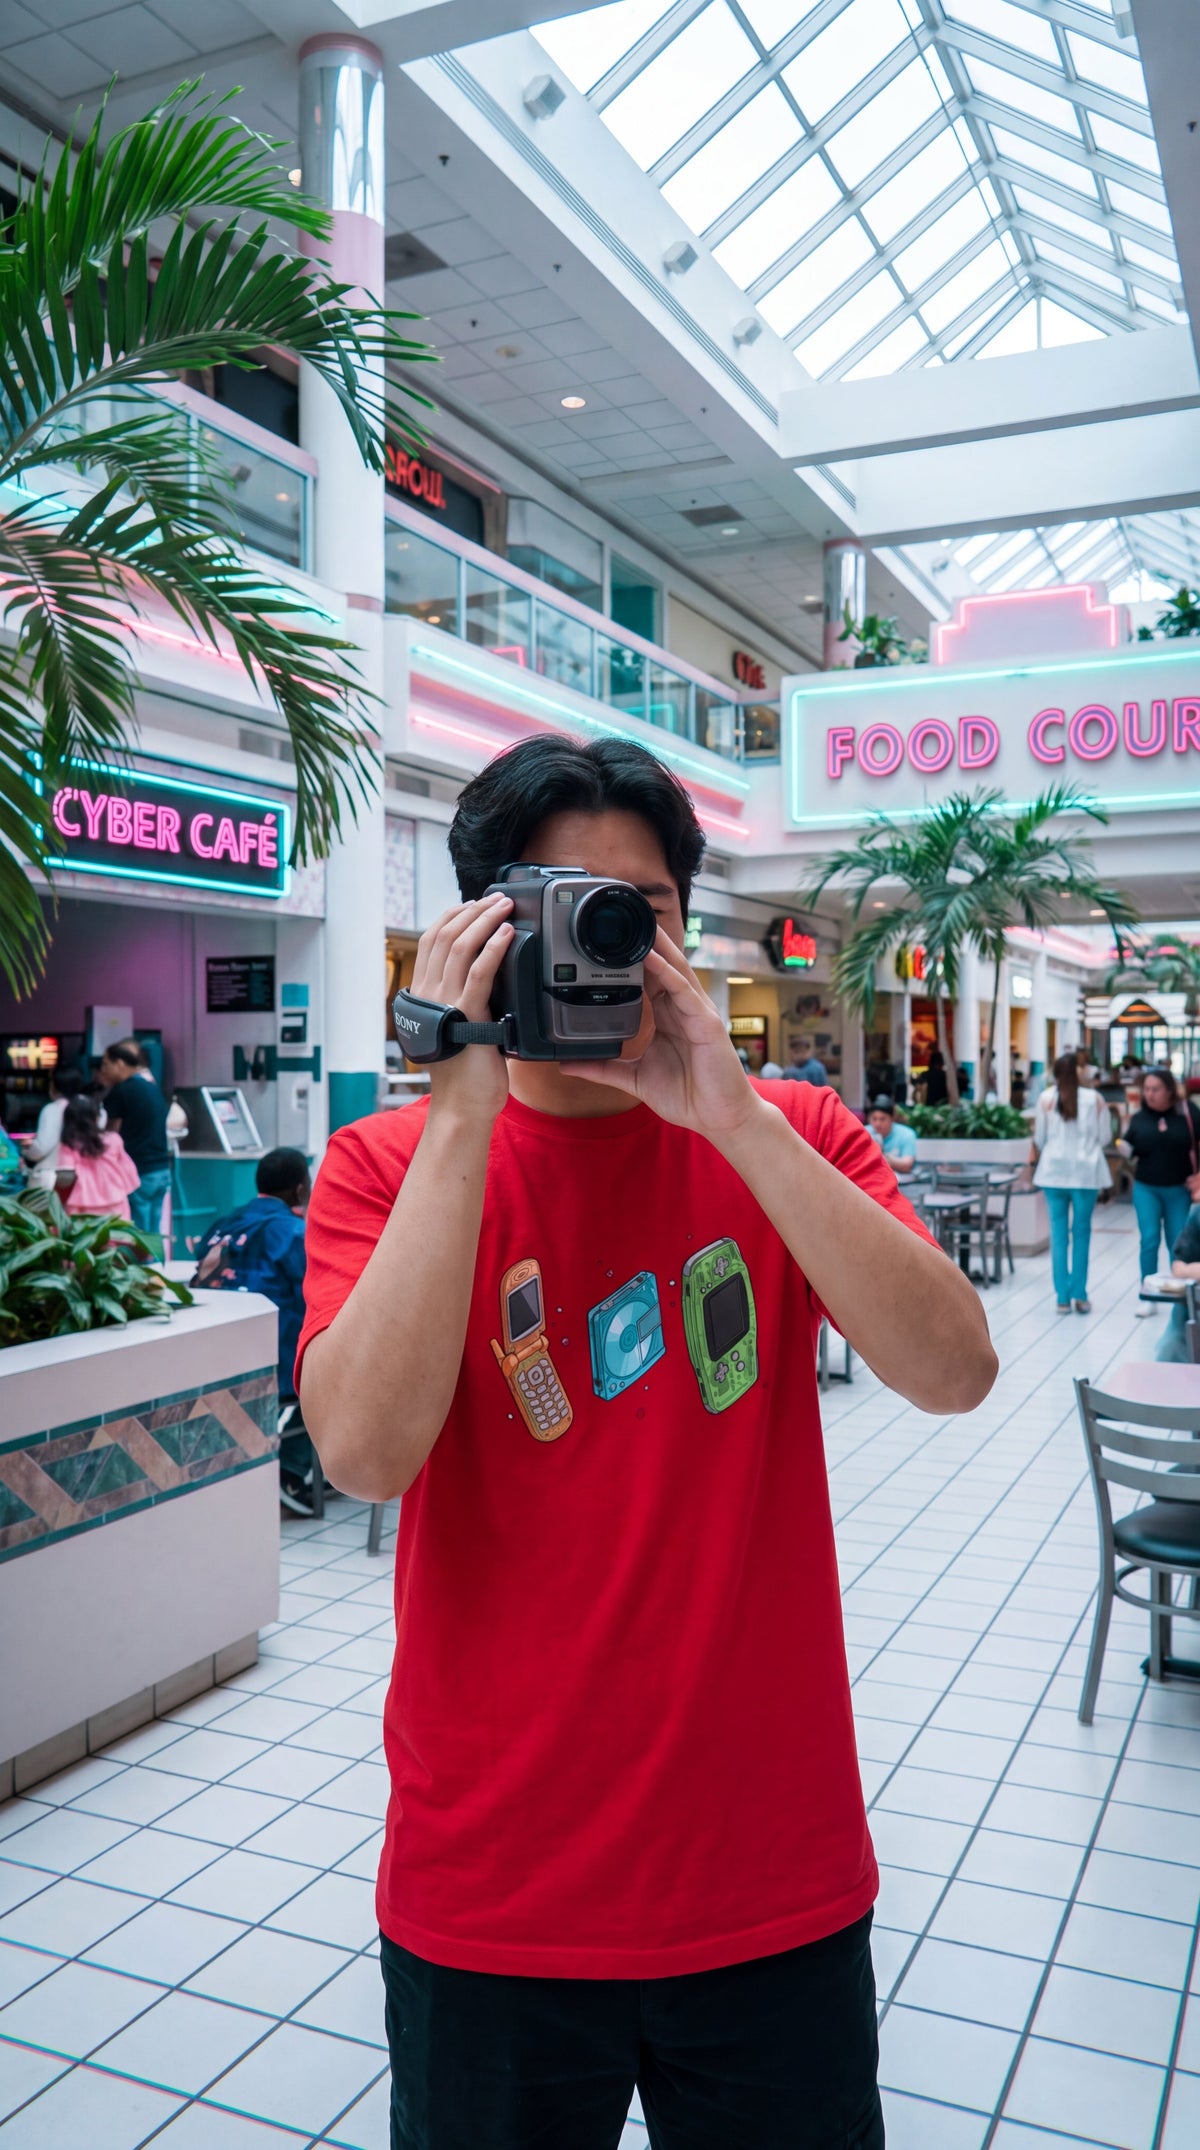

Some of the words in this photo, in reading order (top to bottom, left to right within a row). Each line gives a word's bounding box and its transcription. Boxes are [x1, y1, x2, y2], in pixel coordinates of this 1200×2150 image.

[827, 716, 999, 778] FOOD
[1028, 696, 1200, 764] COUR
[52, 787, 181, 853] CYBER
[190, 813, 278, 868] CAFÉ
[395, 1012, 421, 1034] SONY
